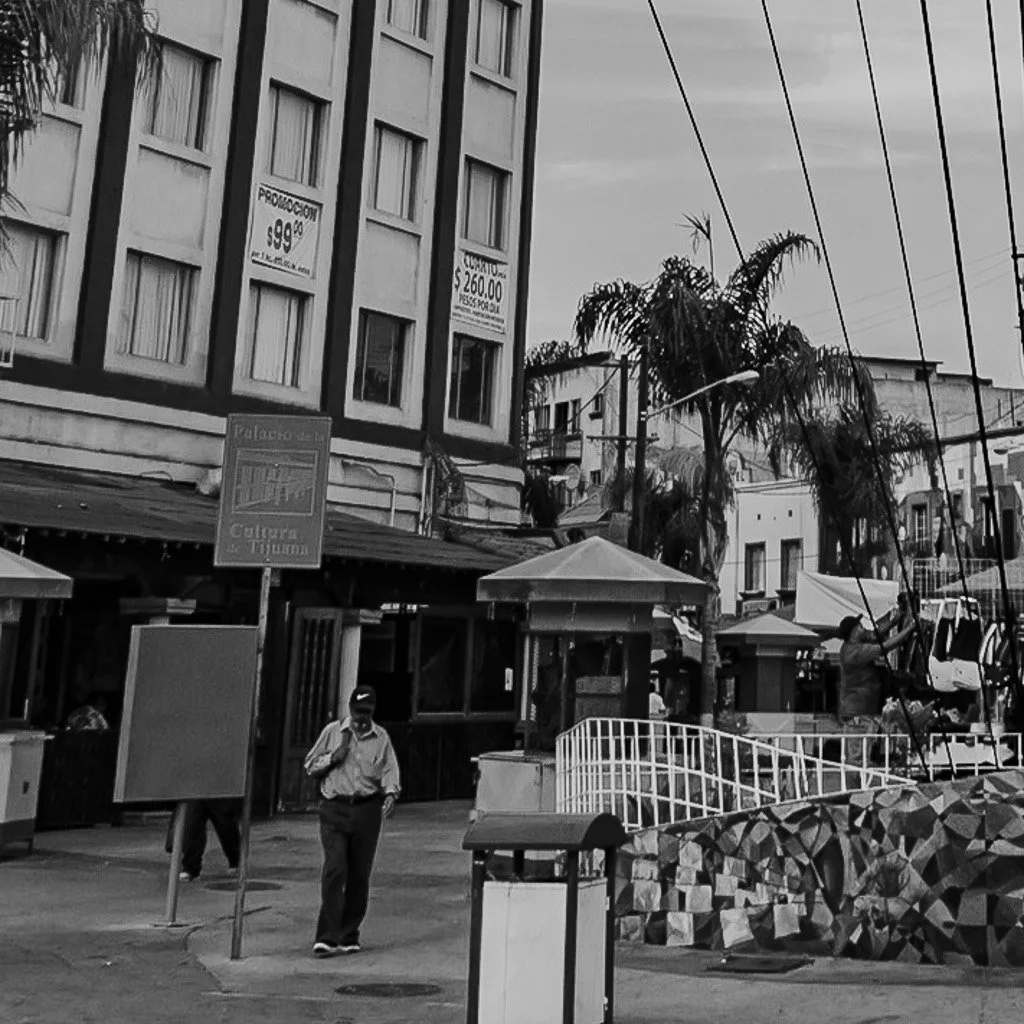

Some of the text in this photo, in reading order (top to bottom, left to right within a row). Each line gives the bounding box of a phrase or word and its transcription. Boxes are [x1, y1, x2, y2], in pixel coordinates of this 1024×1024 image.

[257, 186, 318, 223] PROMOCION
[229, 523, 298, 540] Cultura
[246, 538, 309, 559] Tijuana
